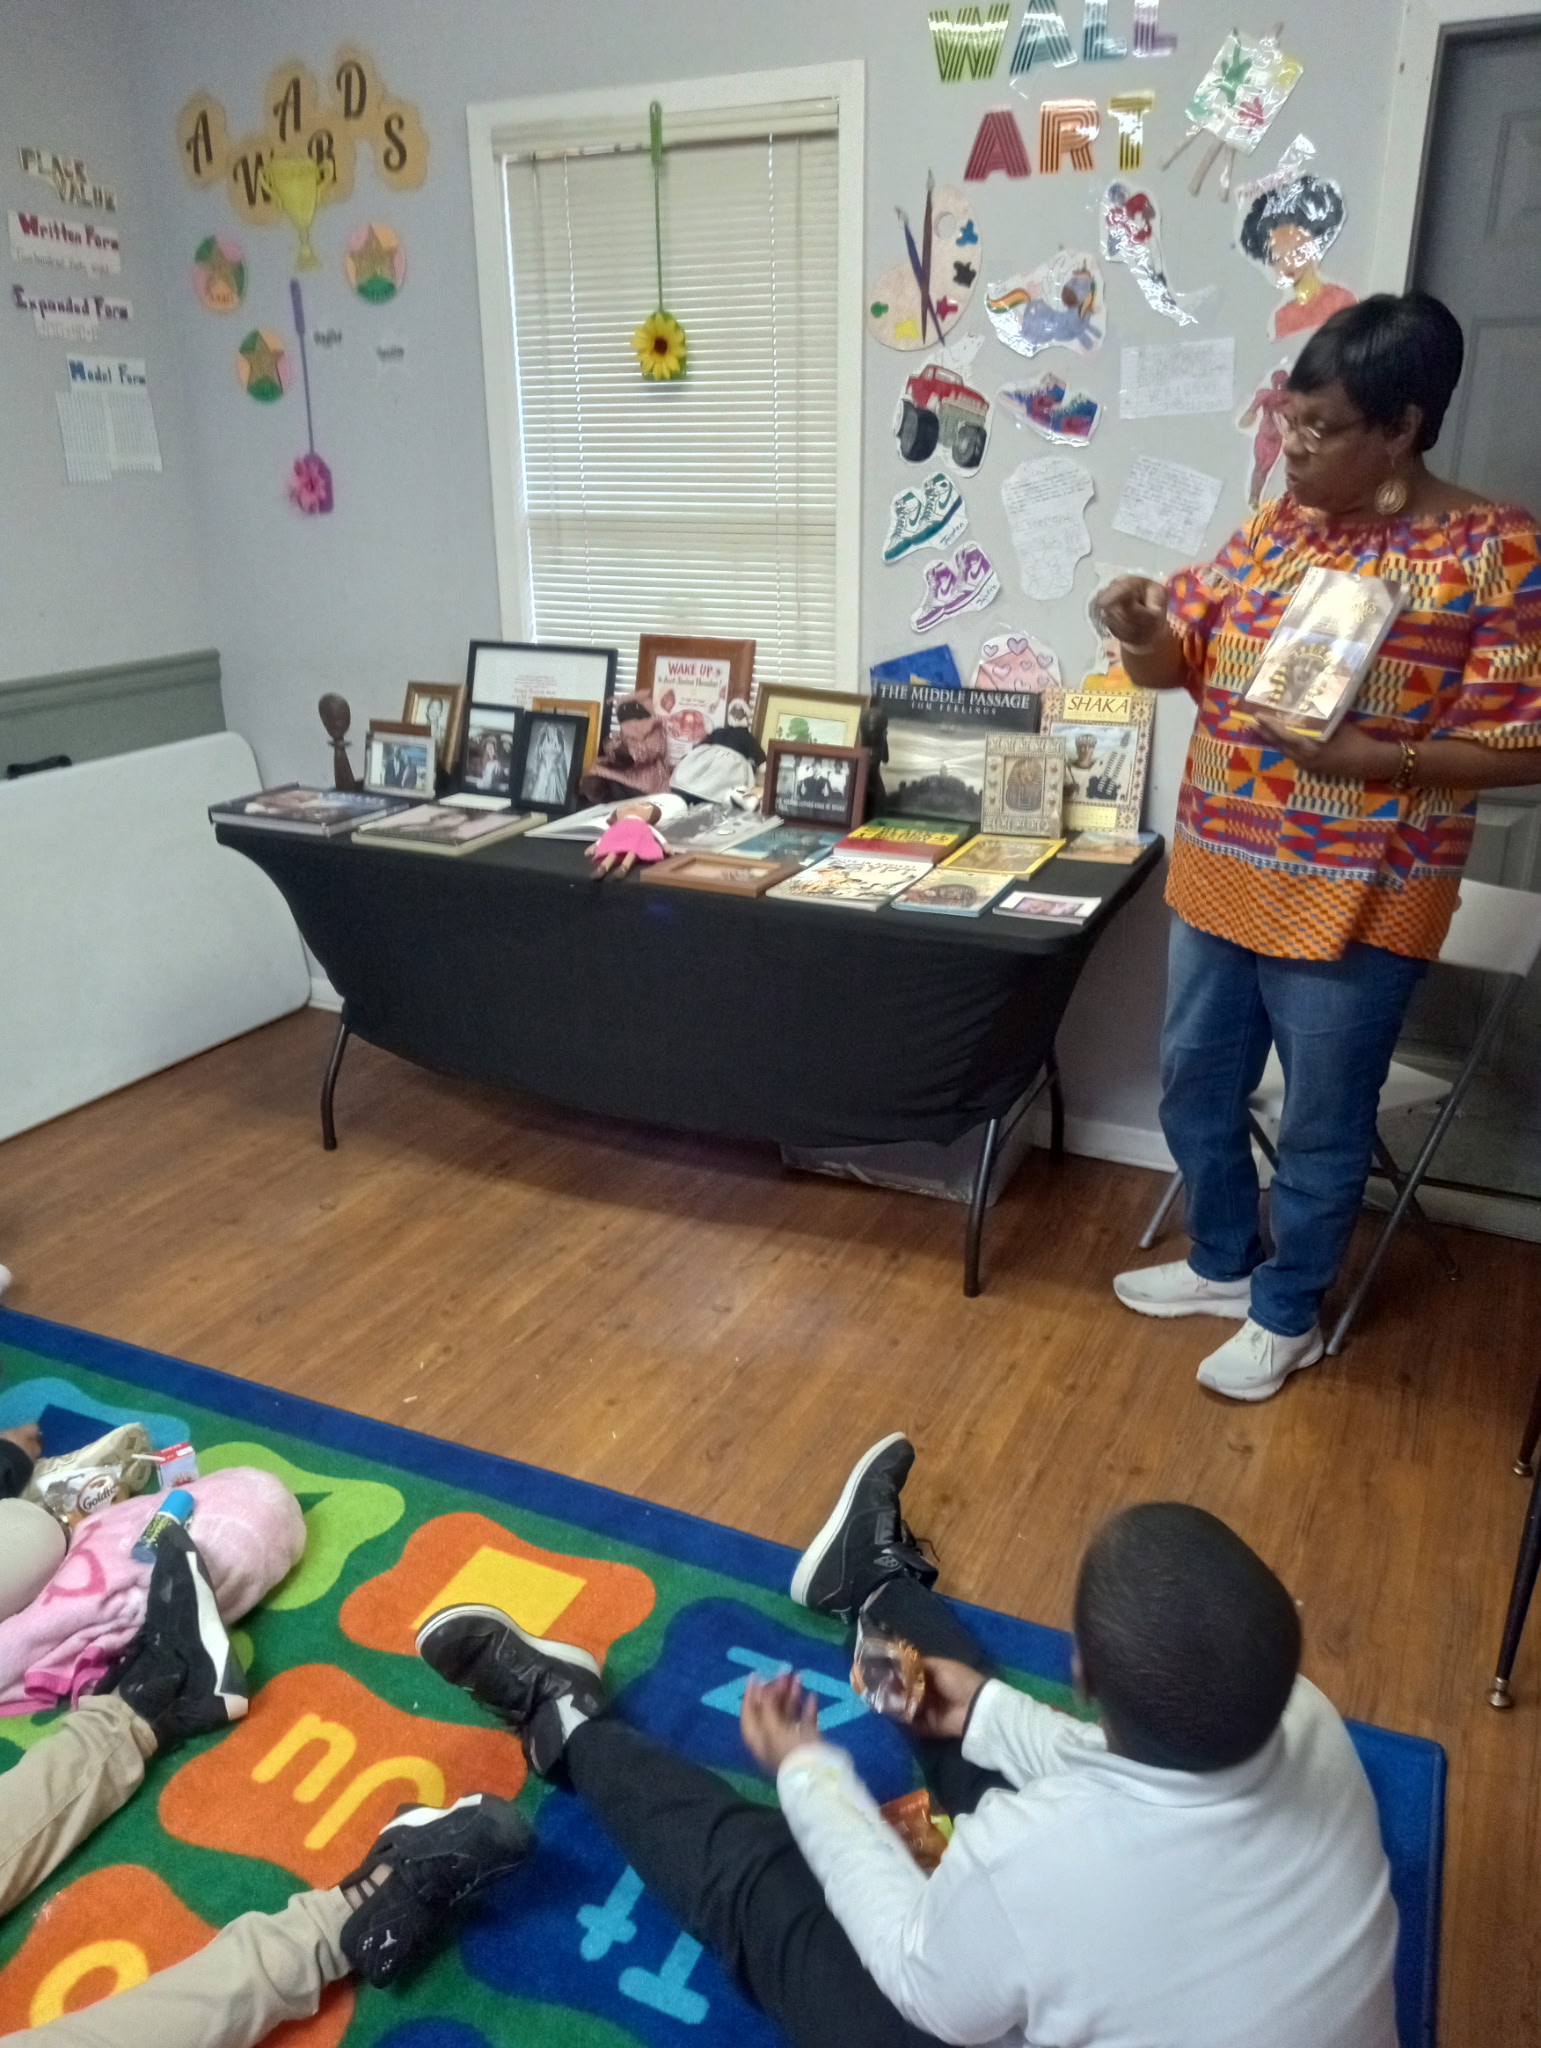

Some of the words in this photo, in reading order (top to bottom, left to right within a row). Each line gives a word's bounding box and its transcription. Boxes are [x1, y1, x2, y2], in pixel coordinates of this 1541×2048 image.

[927, 0, 1178, 83] WALL
[964, 90, 1155, 181] ART
[18, 211, 82, 244] Written
[84, 223, 120, 251] Form
[12, 283, 90, 319] Expanded
[94, 296, 129, 319] Form
[68, 359, 113, 384] Model
[117, 363, 147, 385] Form
[668, 661, 695, 676] WAKE
[699, 663, 714, 678] UP
[880, 683, 908, 700] THE
[911, 686, 966, 704] MIDDLE
[969, 693, 1030, 710] PASSAGE
[1068, 696, 1129, 713] SHAKA
